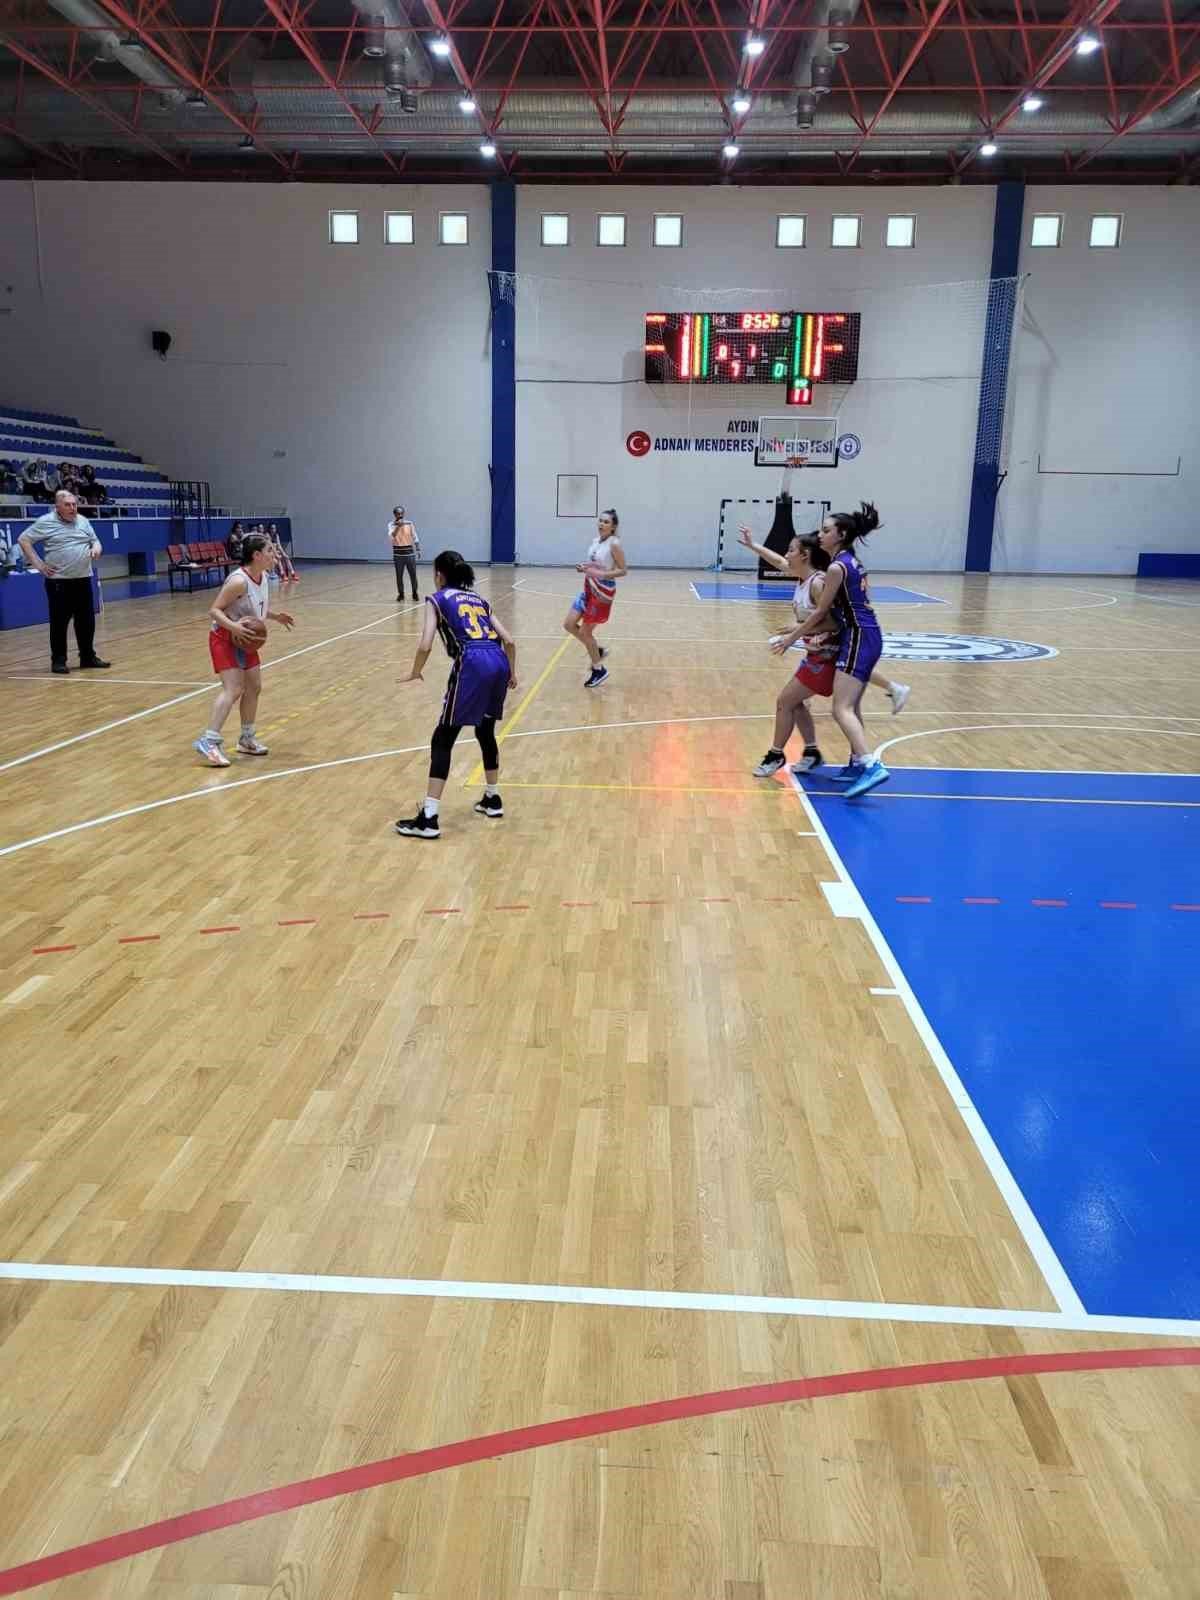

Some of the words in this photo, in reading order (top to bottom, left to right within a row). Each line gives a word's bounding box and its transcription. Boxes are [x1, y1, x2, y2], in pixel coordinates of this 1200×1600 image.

[727, 420, 758, 433] AYDIN
[654, 438, 690, 451] ADNAN
[695, 439, 754, 452] MENDERES
